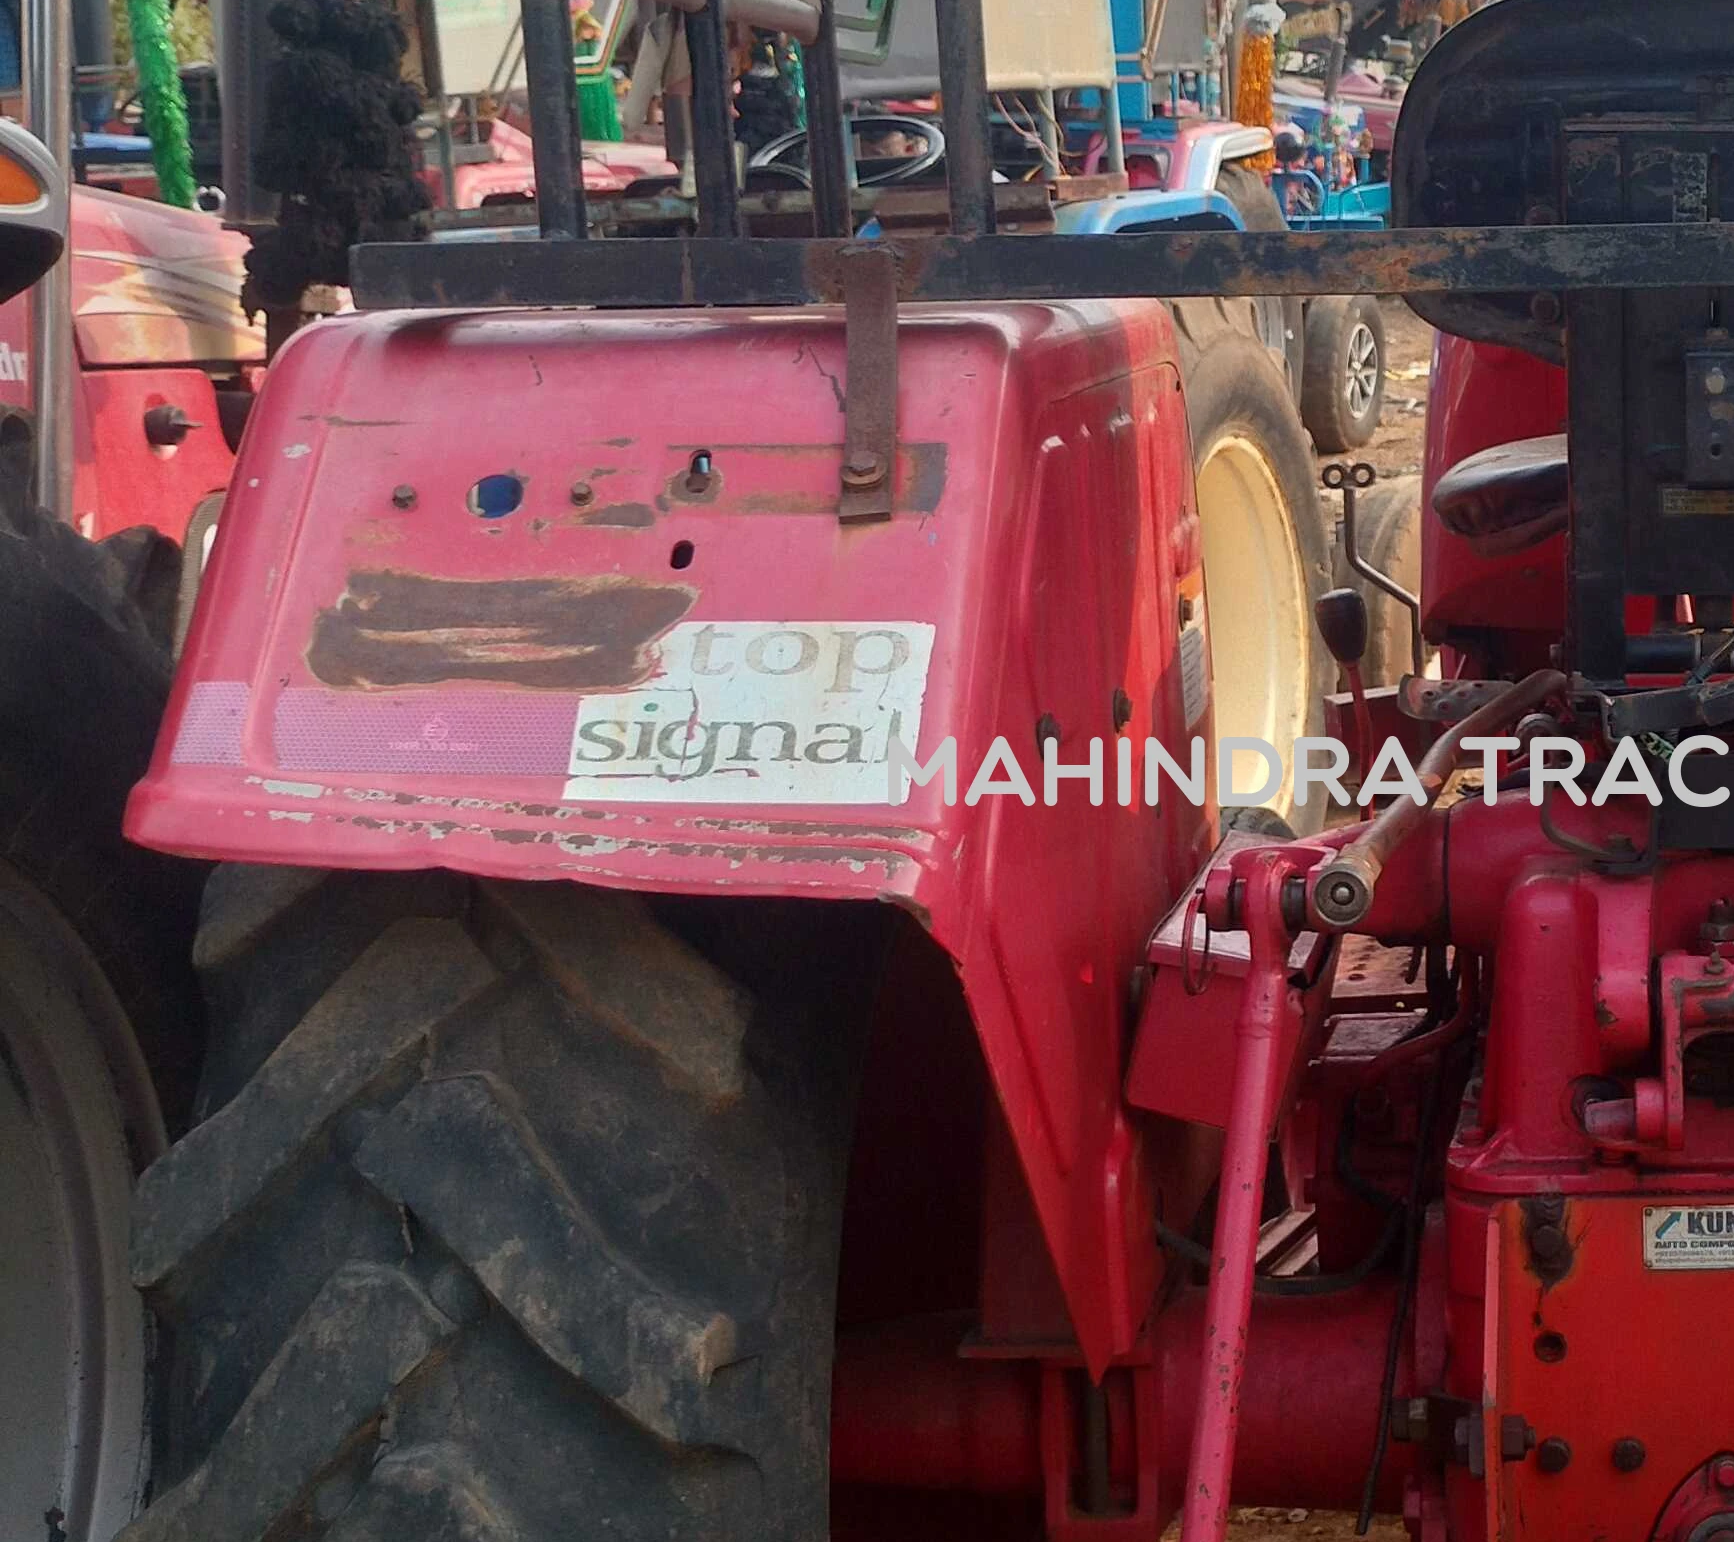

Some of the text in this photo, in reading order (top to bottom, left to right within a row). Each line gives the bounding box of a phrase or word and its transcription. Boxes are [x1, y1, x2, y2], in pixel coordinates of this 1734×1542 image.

[690, 622, 911, 694] top
[576, 709, 904, 780] signal
[1654, 1239, 1688, 1250] AUTO
